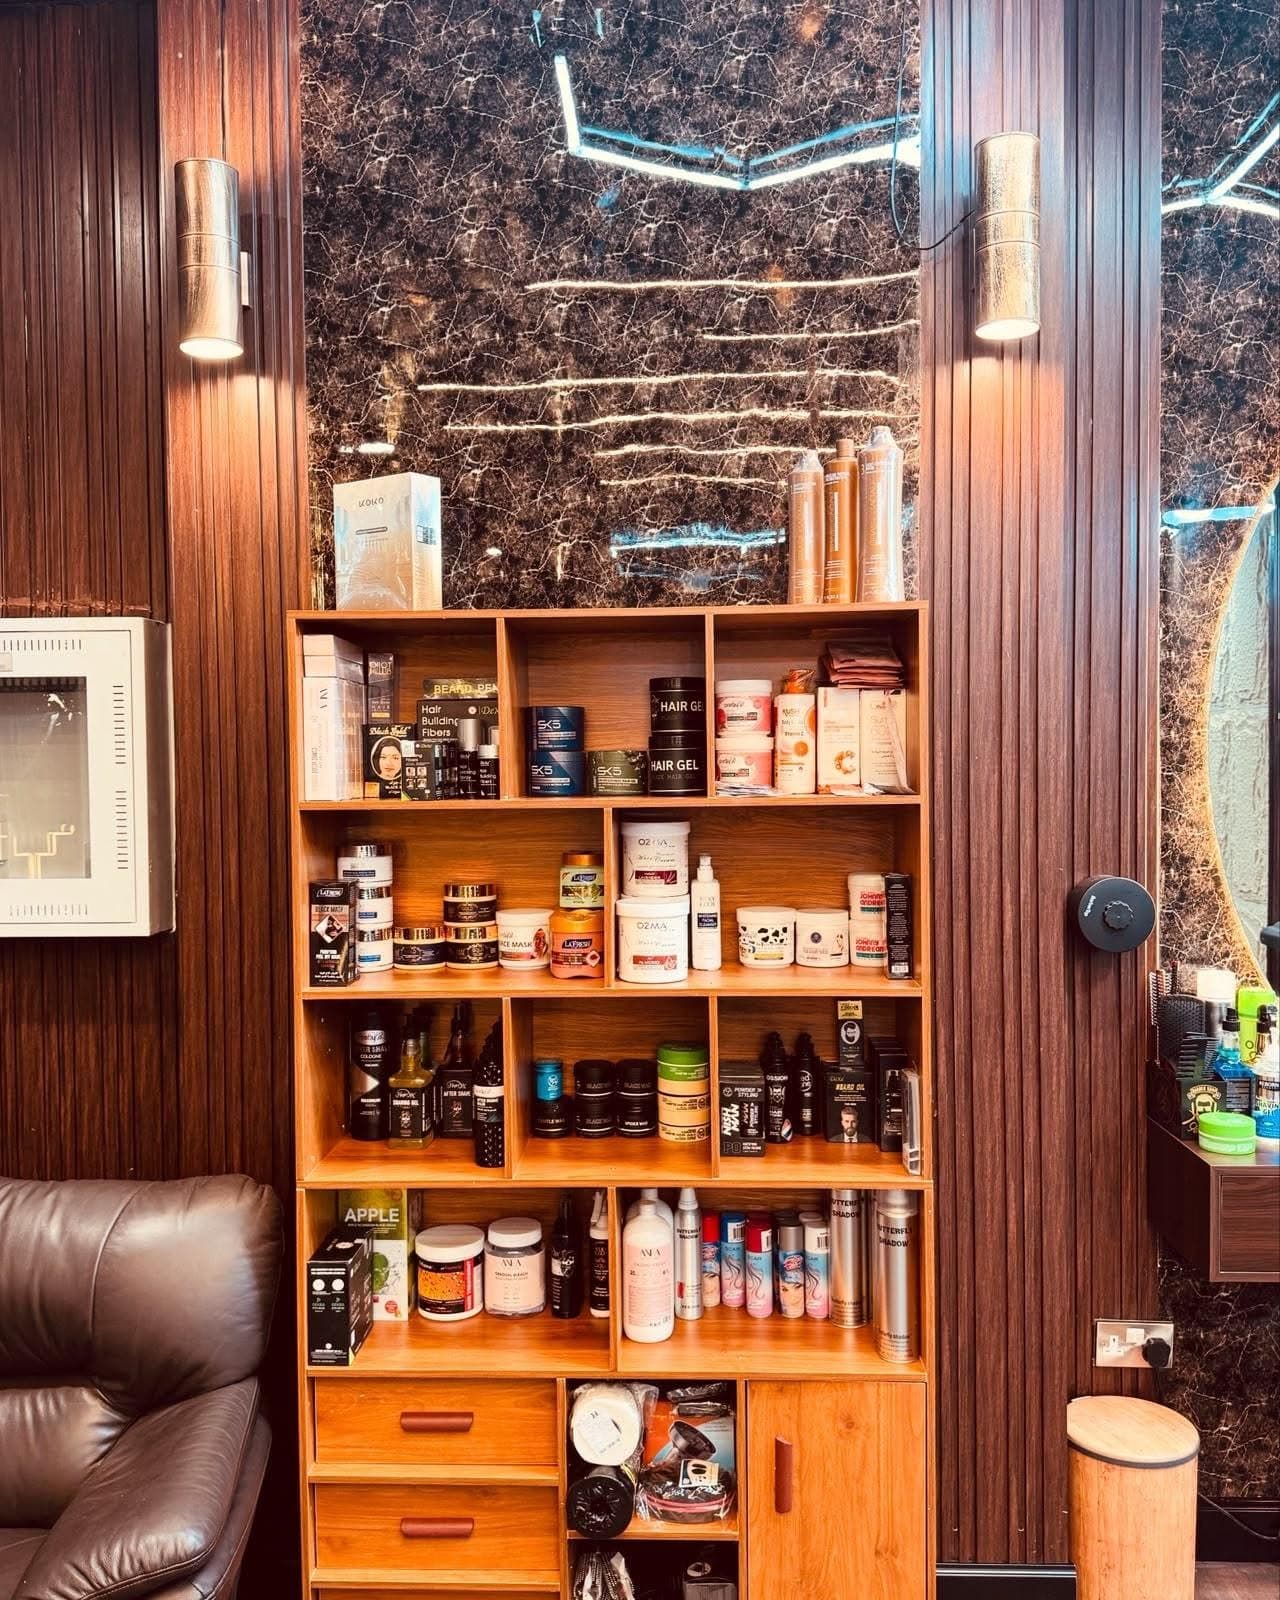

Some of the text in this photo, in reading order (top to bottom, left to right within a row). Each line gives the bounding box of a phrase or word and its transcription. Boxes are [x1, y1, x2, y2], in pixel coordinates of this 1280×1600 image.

[358, 497, 385, 508] KOKO
[421, 704, 442, 714] Hair
[659, 701, 704, 712] HAIR GE
[421, 728, 451, 737] Fibers
[650, 759, 700, 772] HAIR GEL
[344, 1207, 400, 1222] APPLE
